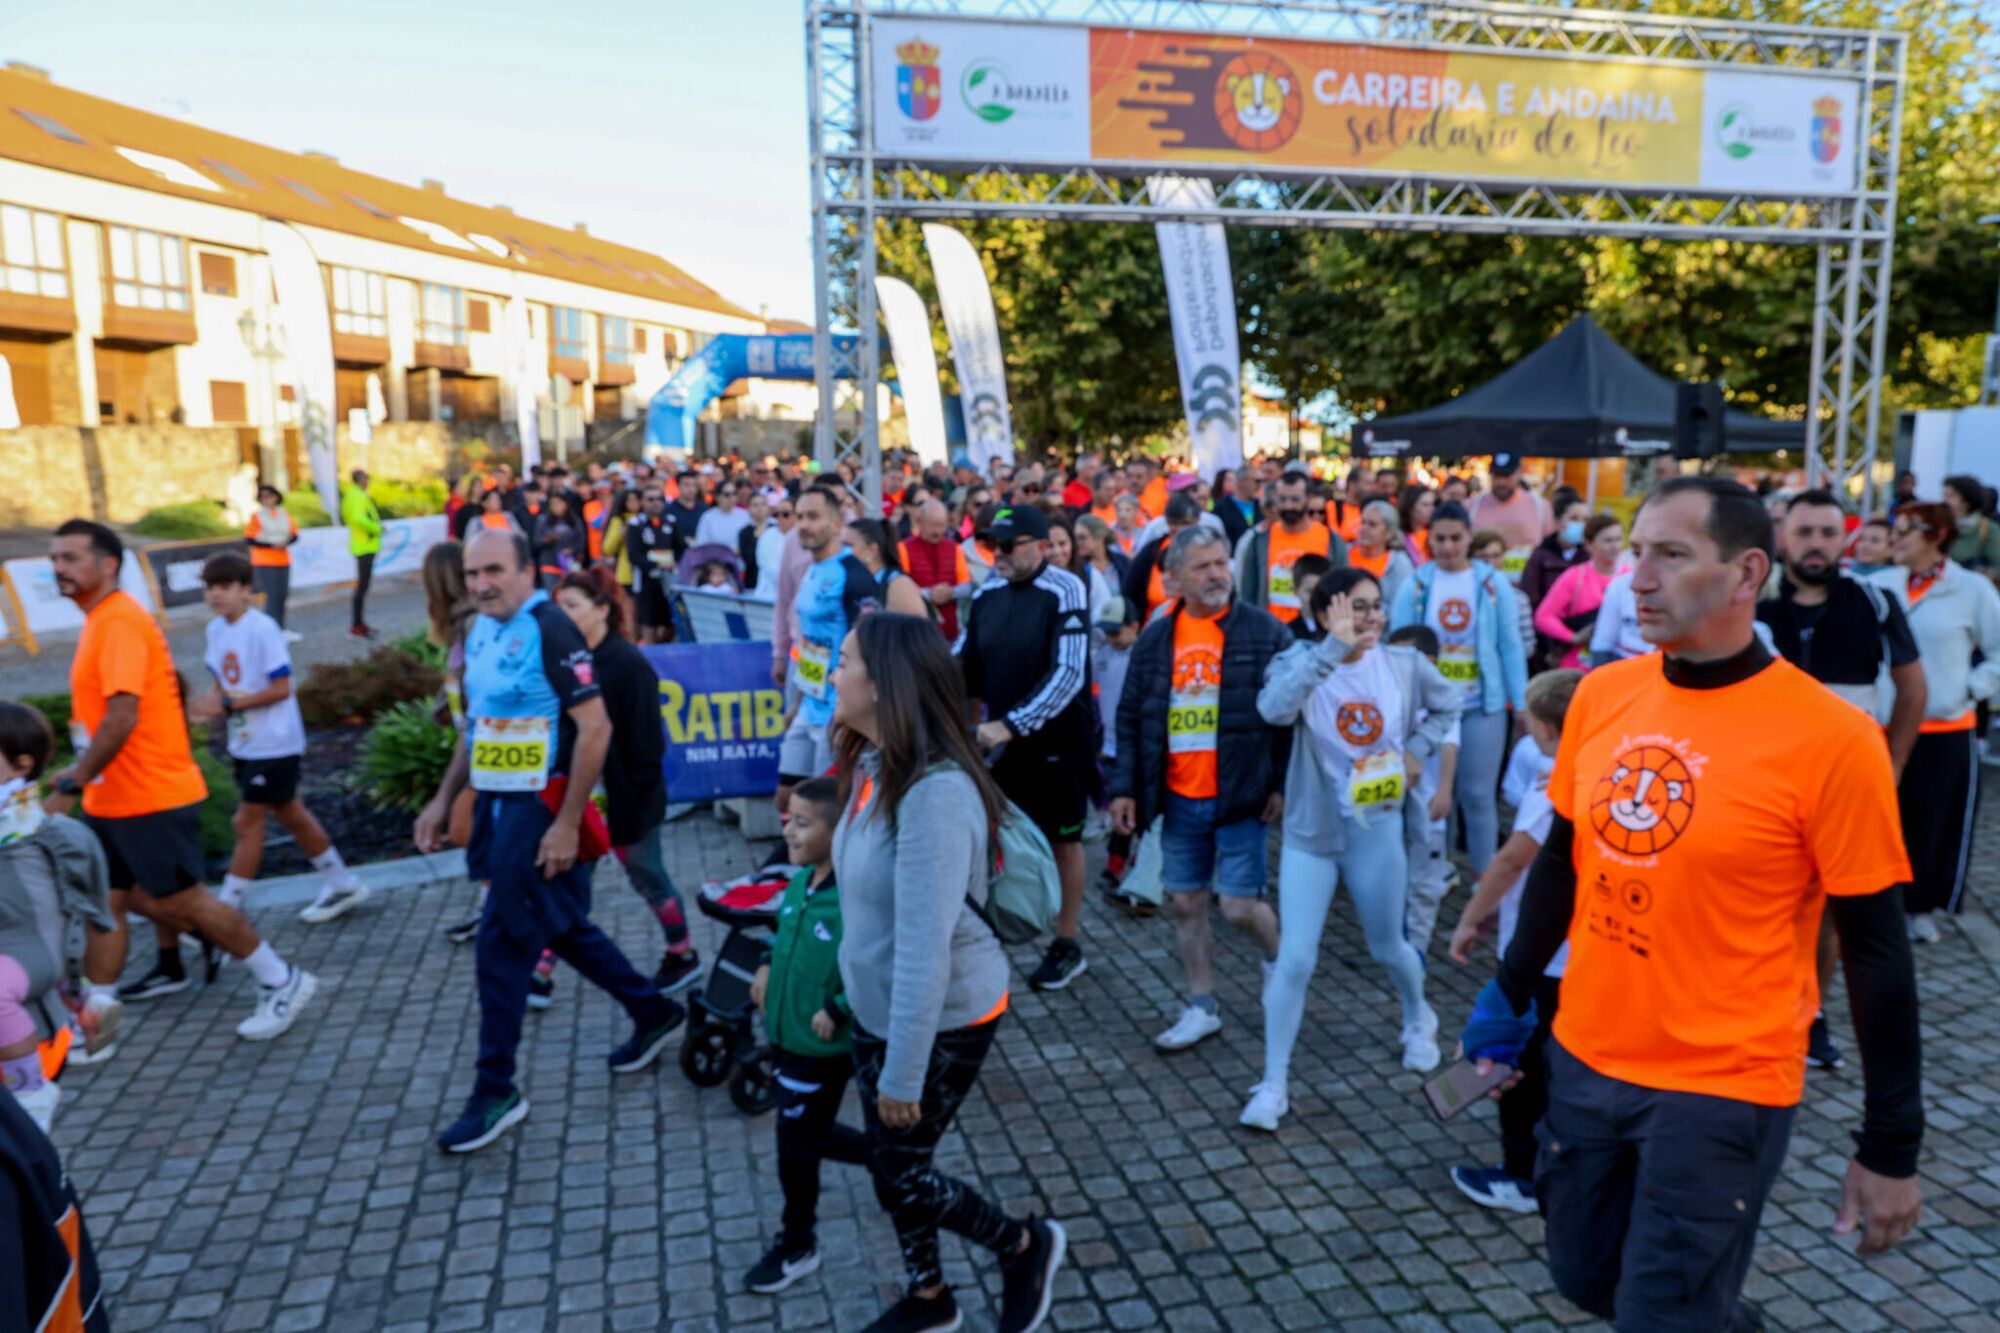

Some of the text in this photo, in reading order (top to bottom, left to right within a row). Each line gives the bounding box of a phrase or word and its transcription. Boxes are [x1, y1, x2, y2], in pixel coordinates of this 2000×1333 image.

[1313, 69, 1677, 124] CARREIRA E ANDAINA
[1534, 112, 1580, 157] de
[476, 745, 542, 768] 2205
[686, 746, 719, 763] NIN
